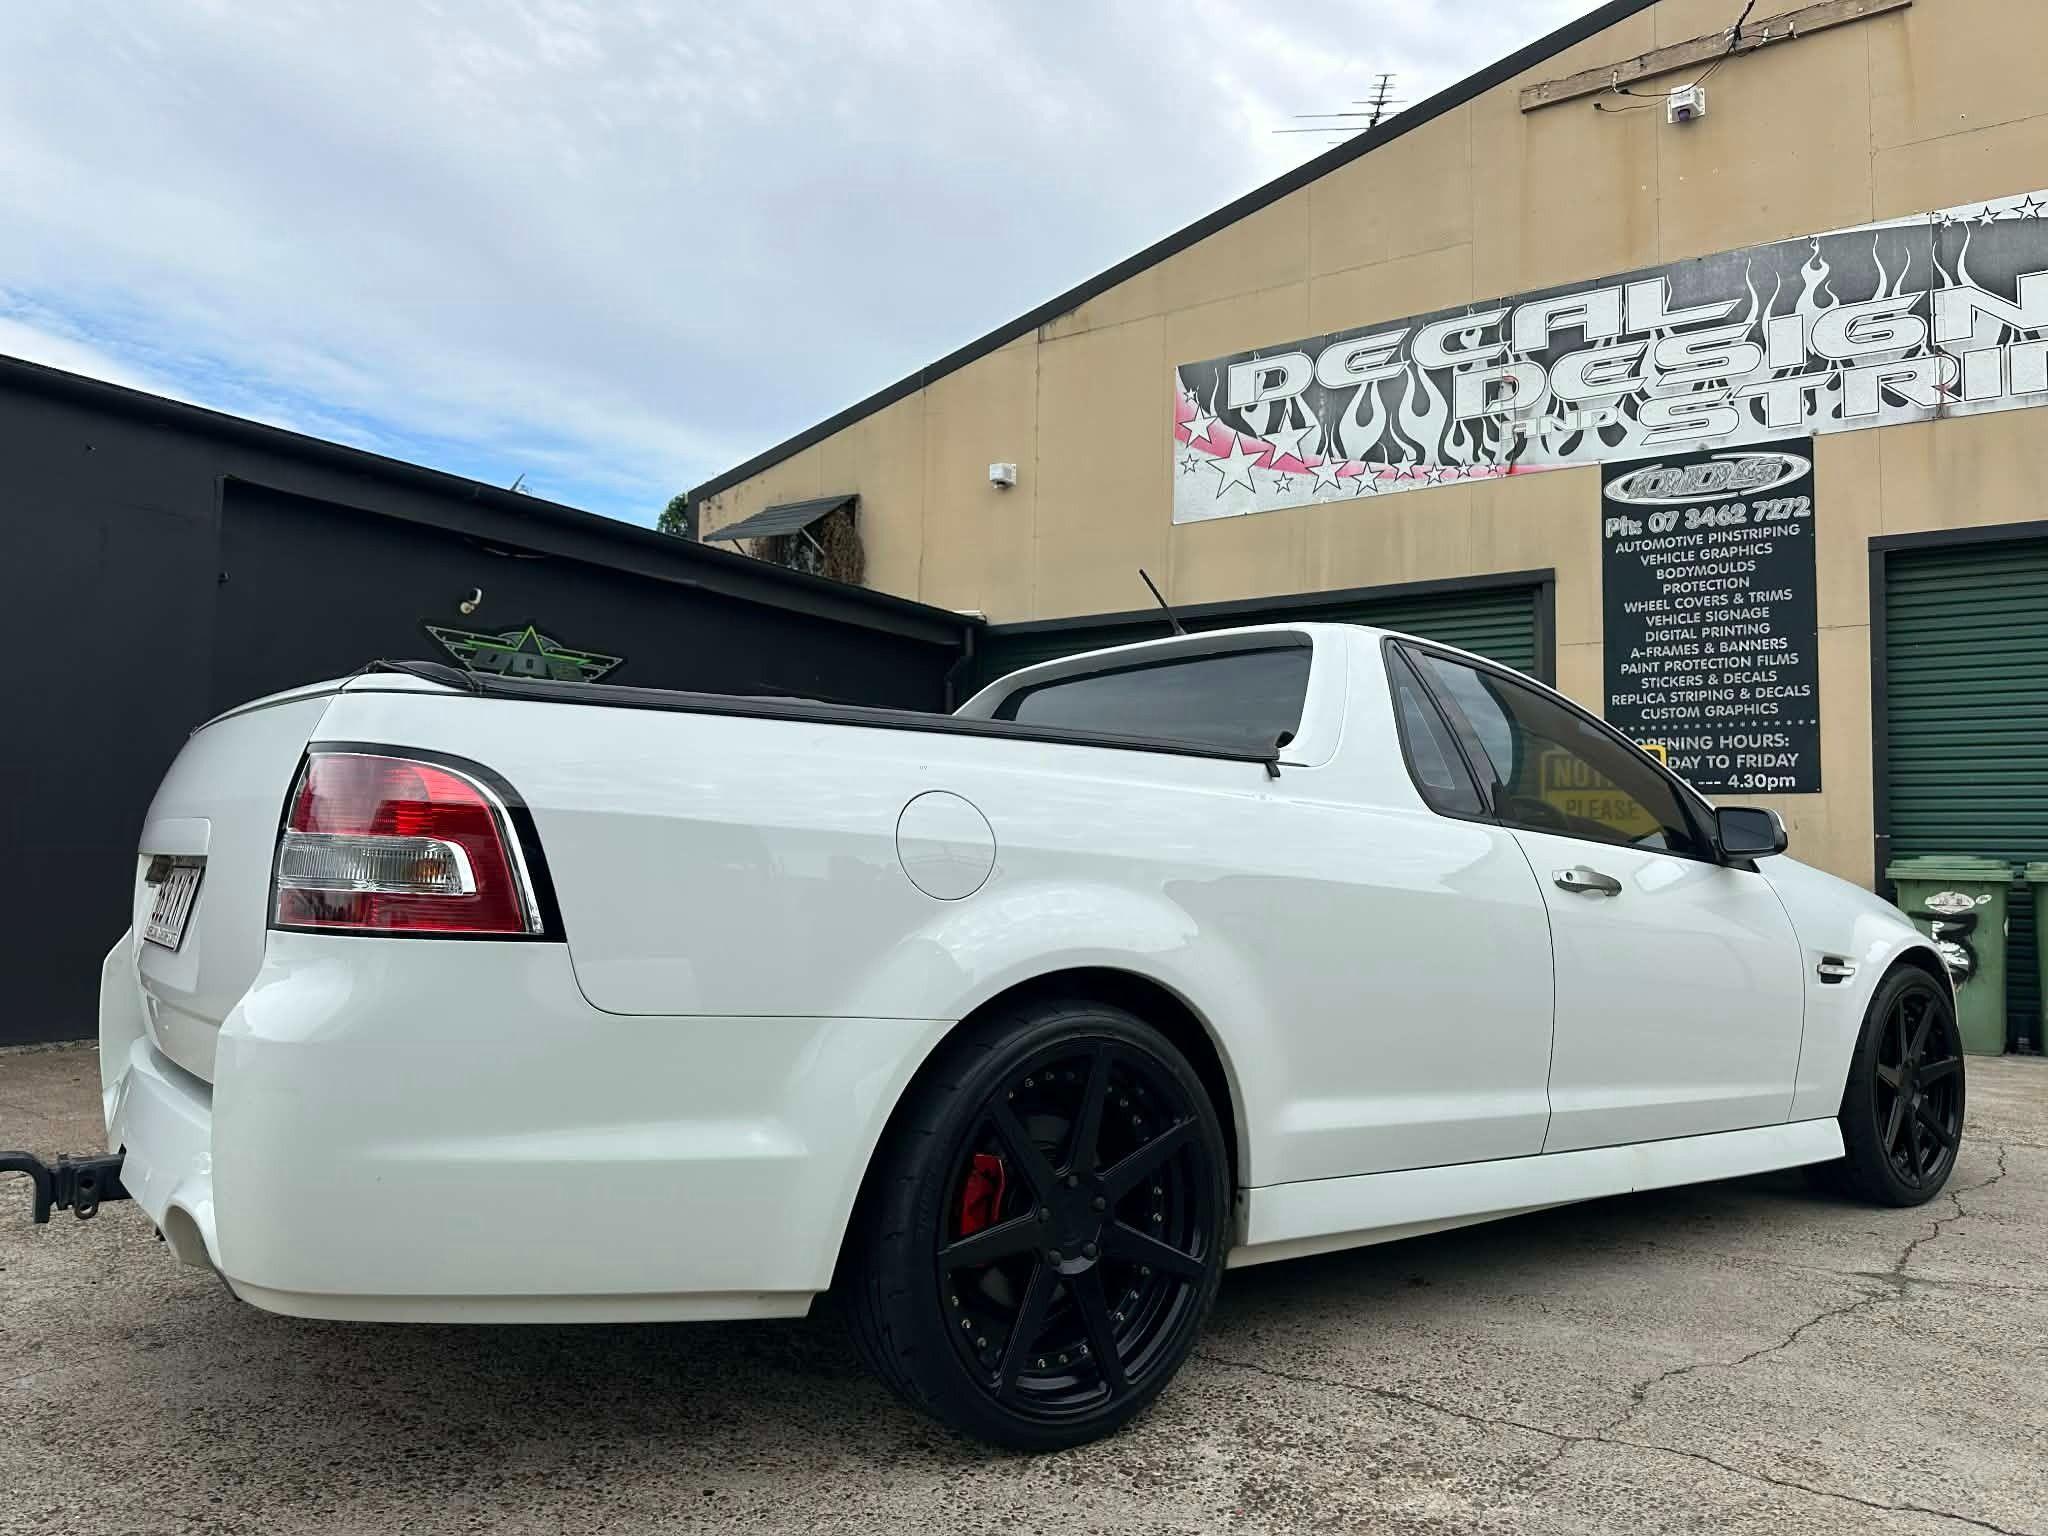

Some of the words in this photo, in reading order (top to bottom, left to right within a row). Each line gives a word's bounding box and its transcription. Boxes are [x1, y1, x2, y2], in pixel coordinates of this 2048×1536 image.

[1227, 277, 1741, 410] DECAL
[1606, 516, 1642, 538] Ph:
[1648, 511, 1679, 533] 07
[1685, 503, 1747, 529] 3462
[1752, 496, 1811, 522] 7272
[1616, 534, 1703, 553] AUTOMOTIVE
[1708, 524, 1801, 544] PINSTRIPING
[1640, 551, 1695, 566] VEHICLE
[1700, 543, 1773, 559] GRAPHICS
[1656, 560, 1756, 579] BODYMOULDS
[1663, 576, 1750, 594] PROTECTION
[1624, 597, 1670, 613] WHEEL
[1675, 593, 1728, 609] COVERS
[1732, 592, 1744, 604] &
[1748, 589, 1793, 603] TRIMS
[1645, 612, 1701, 627] VEHICLE
[1705, 607, 1770, 622] SIGNAGE
[1645, 629, 1697, 643] DIGITAL
[1701, 623, 1771, 638] PRINTING
[1630, 643, 1699, 659] A-FRAMES
[1703, 642, 1715, 654] &
[1719, 638, 1788, 652] BANNERS
[1620, 661, 1662, 675] PAINT
[1664, 656, 1751, 673] PROTECTION
[1757, 653, 1799, 667] FILMS
[1641, 674, 1703, 689] STICKERS
[1707, 673, 1719, 685] &
[1723, 670, 1777, 684] DECALS
[1611, 692, 1666, 706] REPLICA
[1670, 688, 1735, 703] STRIPING
[1739, 688, 1751, 699] &
[1755, 684, 1811, 698] DECALS
[1641, 706, 1700, 720] CUSTOM
[1704, 702, 1779, 717] GRAPHICS
[1719, 733, 1790, 749] HOURS:
[1705, 754, 1730, 768] TO
[1736, 752, 1800, 768] FRIDAY
[1727, 773, 1797, 791] 4.30pm
